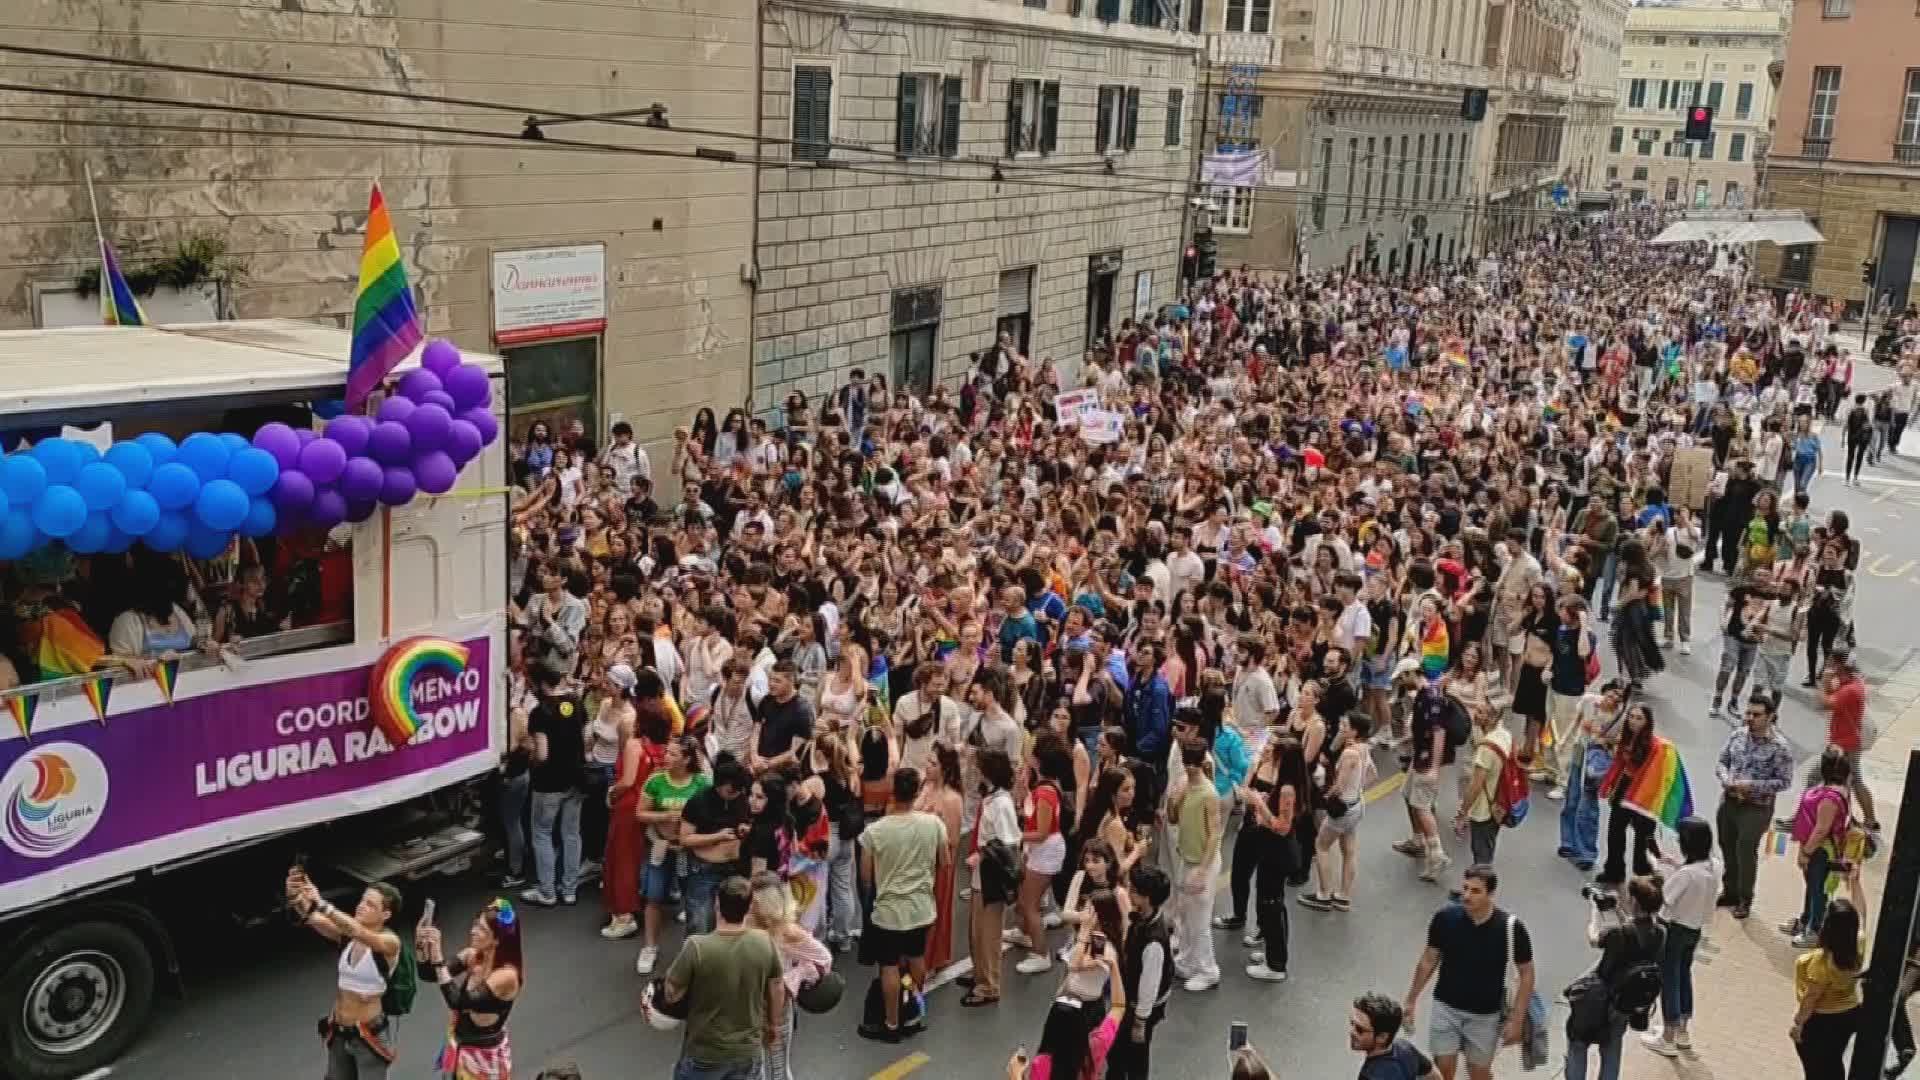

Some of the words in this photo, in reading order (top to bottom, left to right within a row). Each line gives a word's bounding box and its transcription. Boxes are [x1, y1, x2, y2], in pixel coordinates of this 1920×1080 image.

[276, 667, 480, 735] COORDMENTO
[195, 737, 338, 797] LIGURIA
[345, 698, 480, 763] RABOW
[47, 803, 97, 826] LIGURIA
